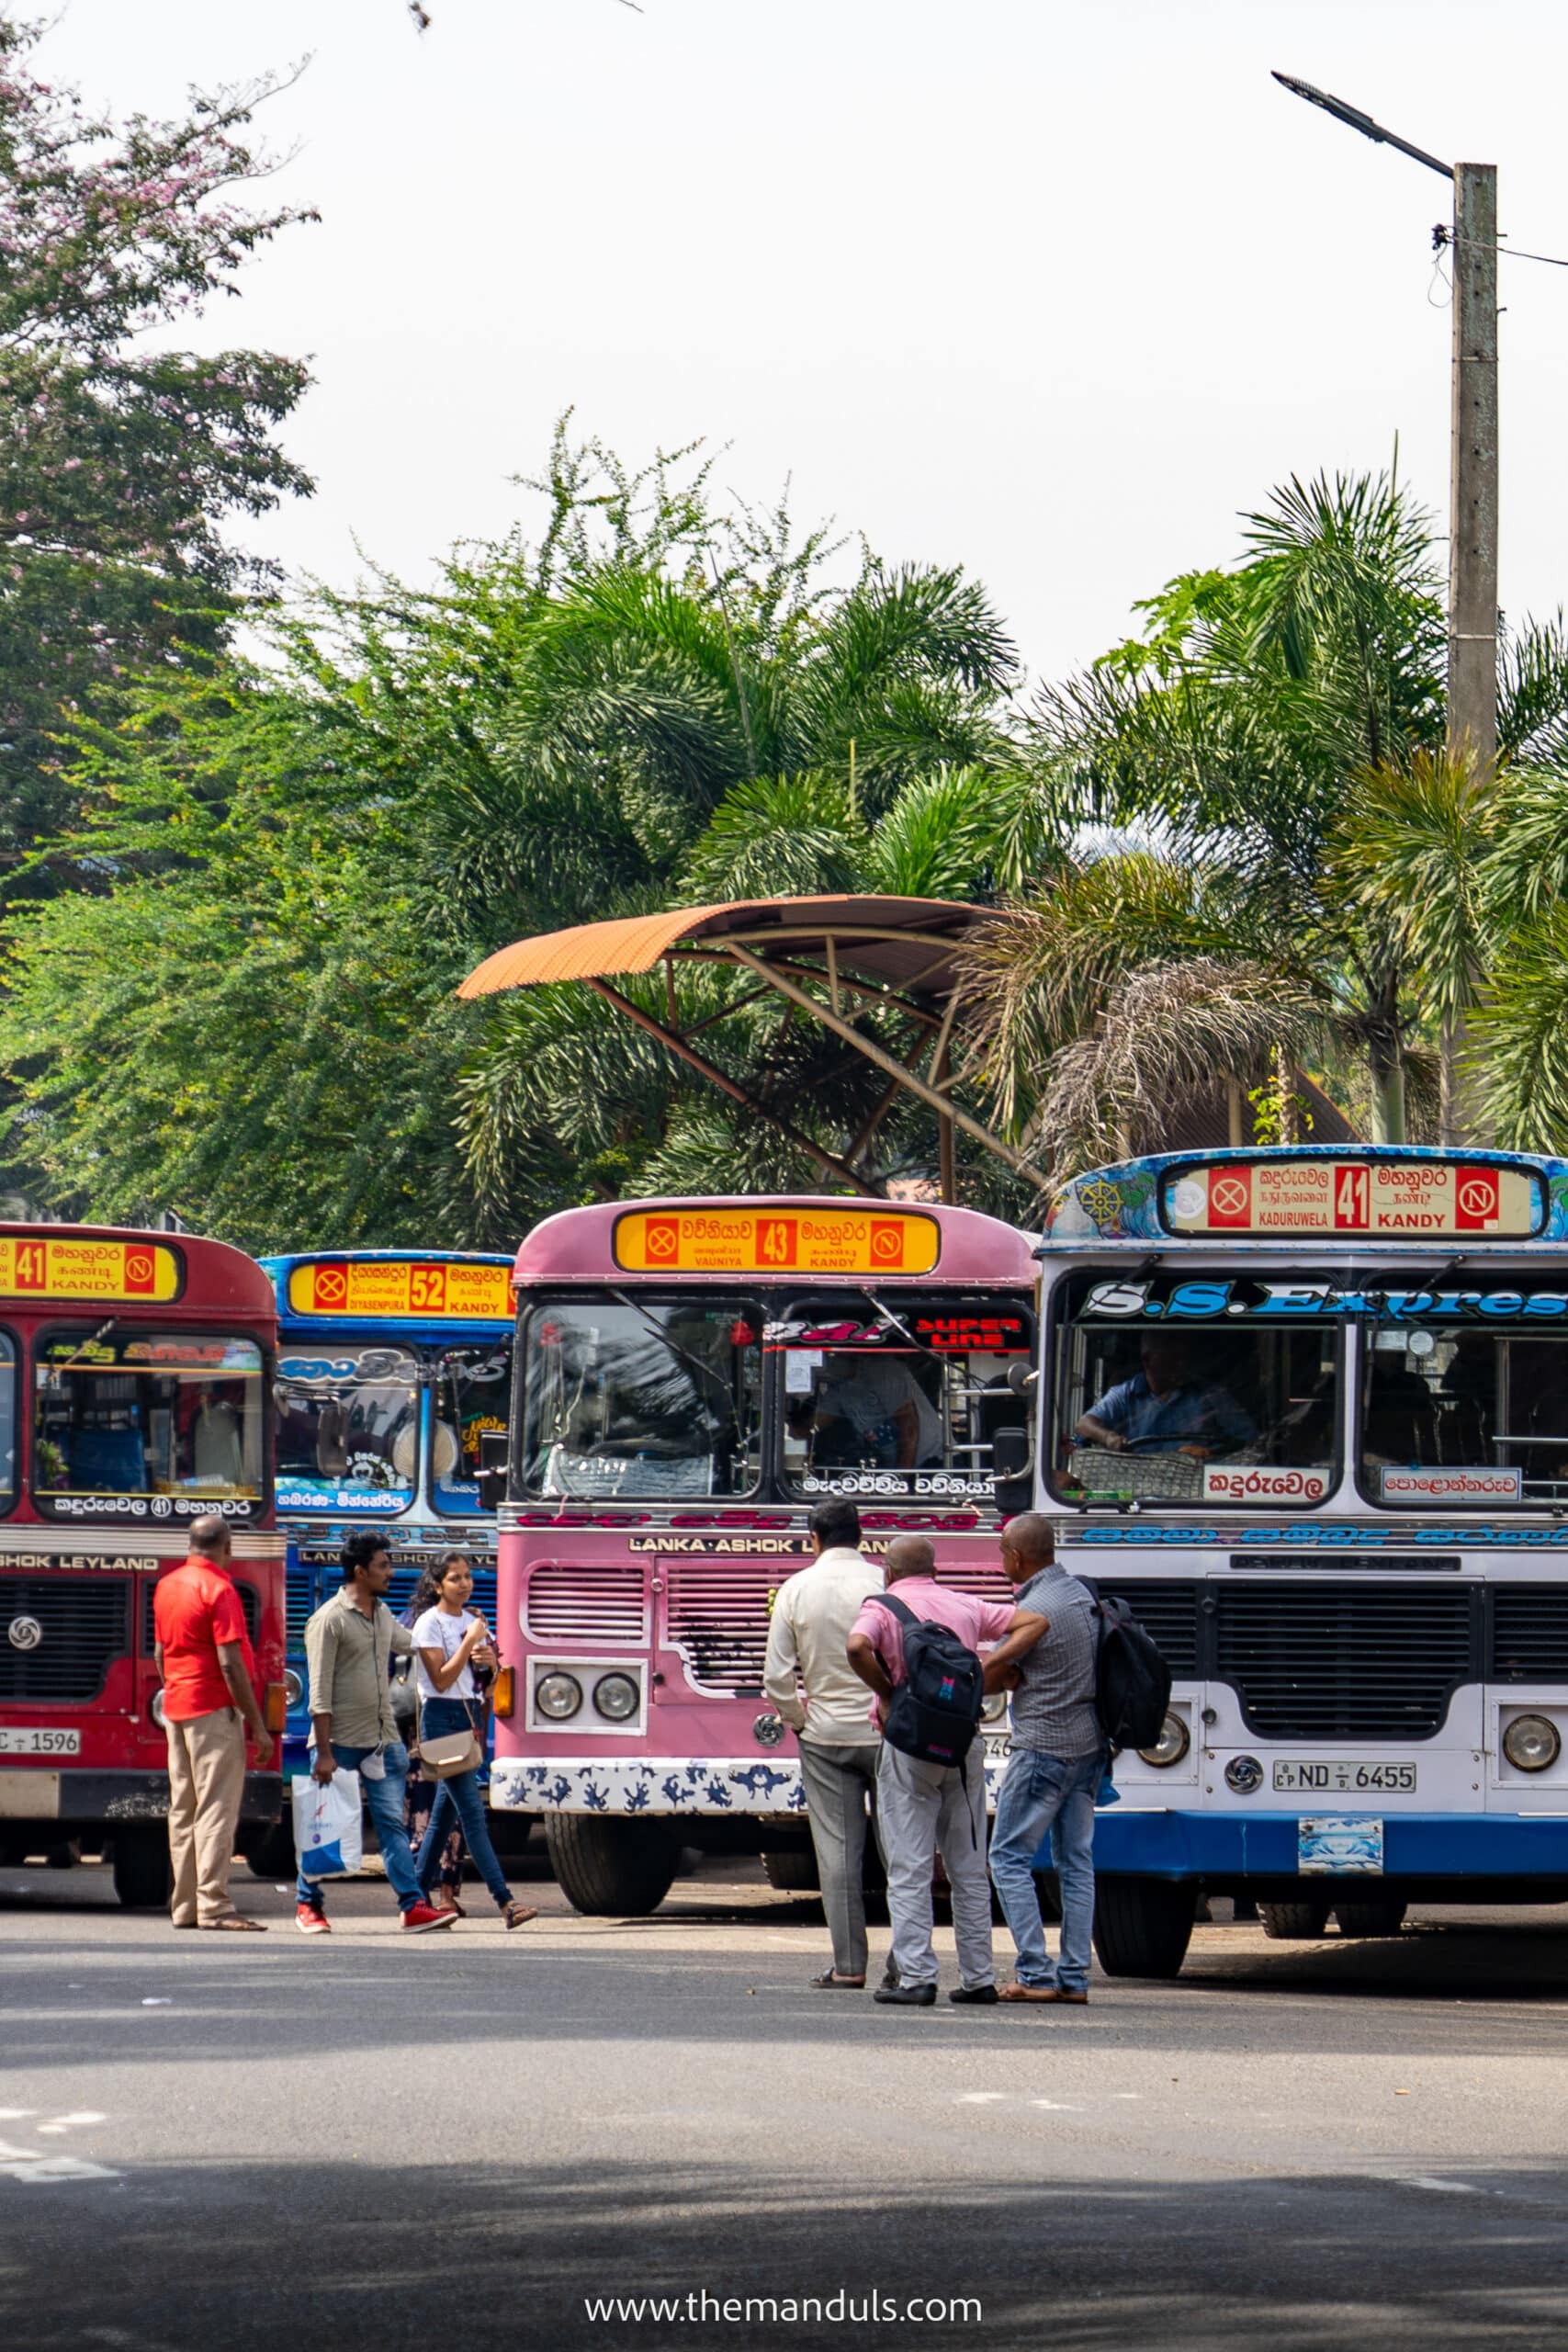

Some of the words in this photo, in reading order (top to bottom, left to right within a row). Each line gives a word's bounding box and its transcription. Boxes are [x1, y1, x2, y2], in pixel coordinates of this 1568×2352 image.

[1259, 1168, 1329, 1190] කදුරුවෙල
[1378, 1168, 1448, 1192] මහනුවර
[1337, 1170, 1368, 1225] 41
[1469, 1187, 1486, 1208] N
[1258, 1212, 1328, 1227] KADURUWELA
[1378, 1213, 1446, 1228] KANDY
[763, 1222, 788, 1262] 43
[801, 1221, 867, 1246] මහනුවර
[880, 1234, 896, 1251] N
[17, 1246, 44, 1284] 41
[51, 1245, 121, 1265] මහනුවර
[694, 1256, 743, 1266] VAUNIYA
[809, 1258, 857, 1267] KANDY
[51, 1280, 120, 1291] KANDY
[449, 1268, 503, 1286] මහනුවර
[411, 1271, 445, 1307] 52
[350, 1299, 405, 1311] DIYASENPURA
[449, 1302, 500, 1314] KANDY
[1089, 1283, 1568, 1320] S.S.Expres
[1208, 1470, 1325, 1500] කදුරුවෙල
[1384, 1474, 1517, 1496] පොළොන්නරුව
[54, 1496, 147, 1515] කදුරුවෙල
[153, 1498, 169, 1516] 41
[628, 1537, 706, 1553] LANKA
[715, 1538, 793, 1554] ASHOK
[59, 1555, 160, 1571] LEYLAND
[302, 1551, 343, 1563] LAN
[390, 1552, 434, 1565] SHO
[30, 1732, 78, 1751] 1596
[1299, 1765, 1329, 1788] ND
[1355, 1765, 1414, 1789] 6455
